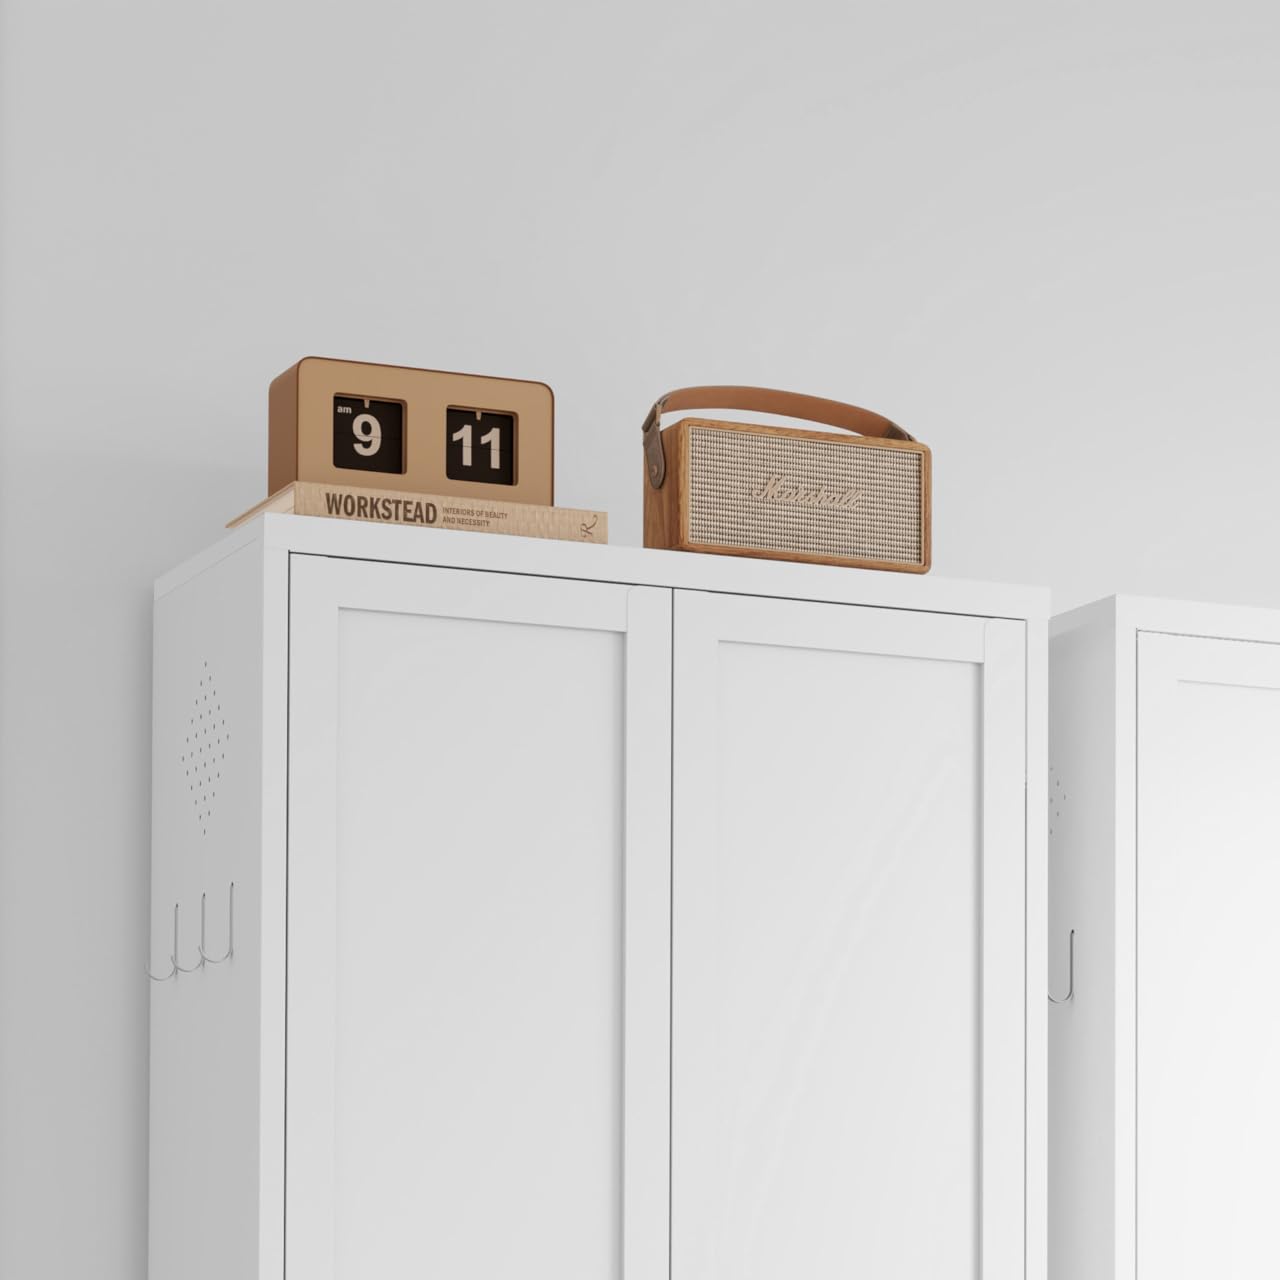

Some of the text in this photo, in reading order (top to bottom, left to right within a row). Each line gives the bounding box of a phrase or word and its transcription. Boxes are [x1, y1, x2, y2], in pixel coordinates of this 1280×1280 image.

[337, 405, 352, 414] am
[352, 413, 382, 456] 9
[452, 424, 500, 469] 11
[752, 475, 861, 508] Marshall
[325, 492, 437, 524] WORKSTEAD
[442, 507, 508, 520] INTERIORS OF BEAUTY
[442, 516, 490, 527] AND NECESSITY
